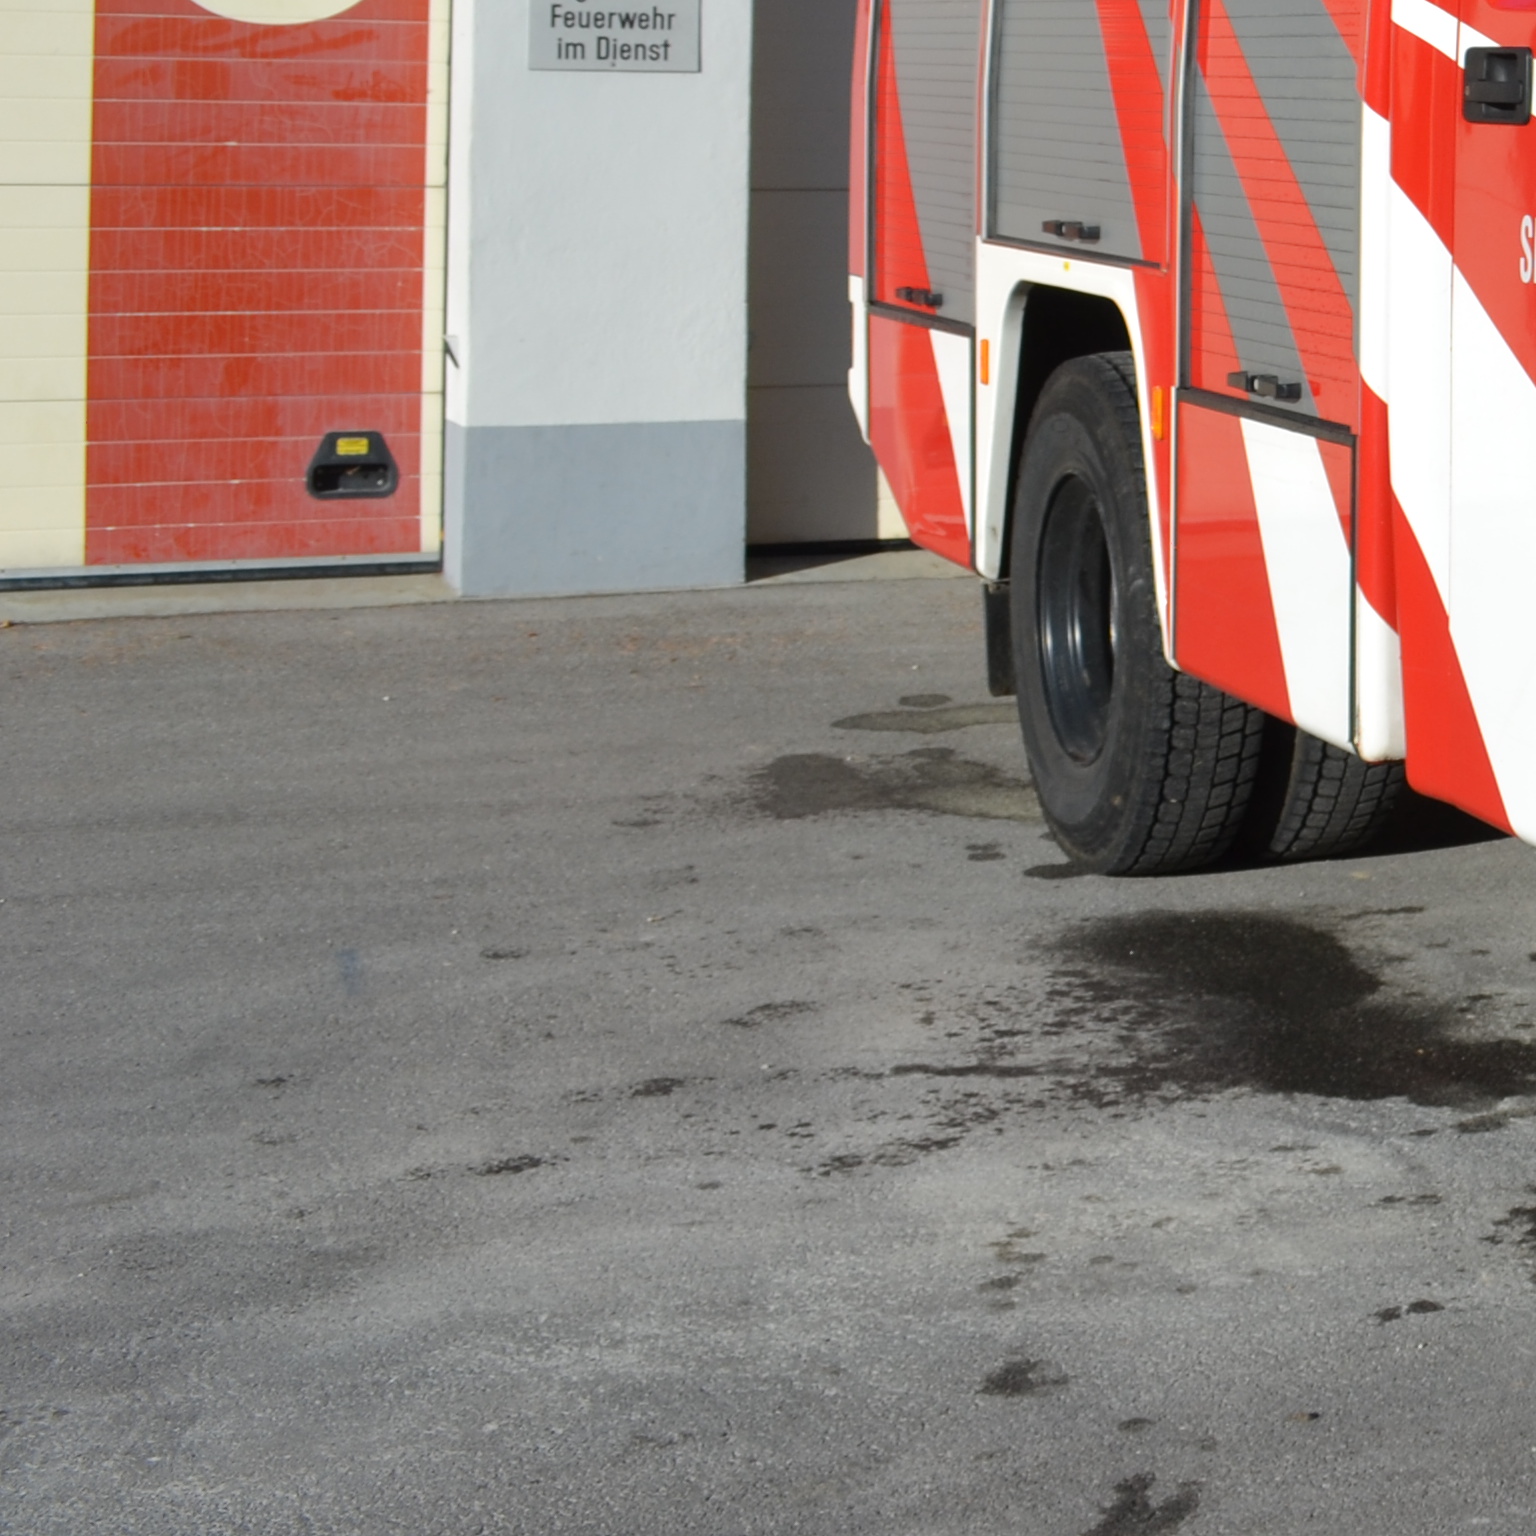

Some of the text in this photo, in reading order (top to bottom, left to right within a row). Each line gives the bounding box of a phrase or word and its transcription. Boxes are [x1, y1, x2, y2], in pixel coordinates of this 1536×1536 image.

[550, 4, 676, 30] Feuerwehr
[557, 36, 671, 61] im Dienst
